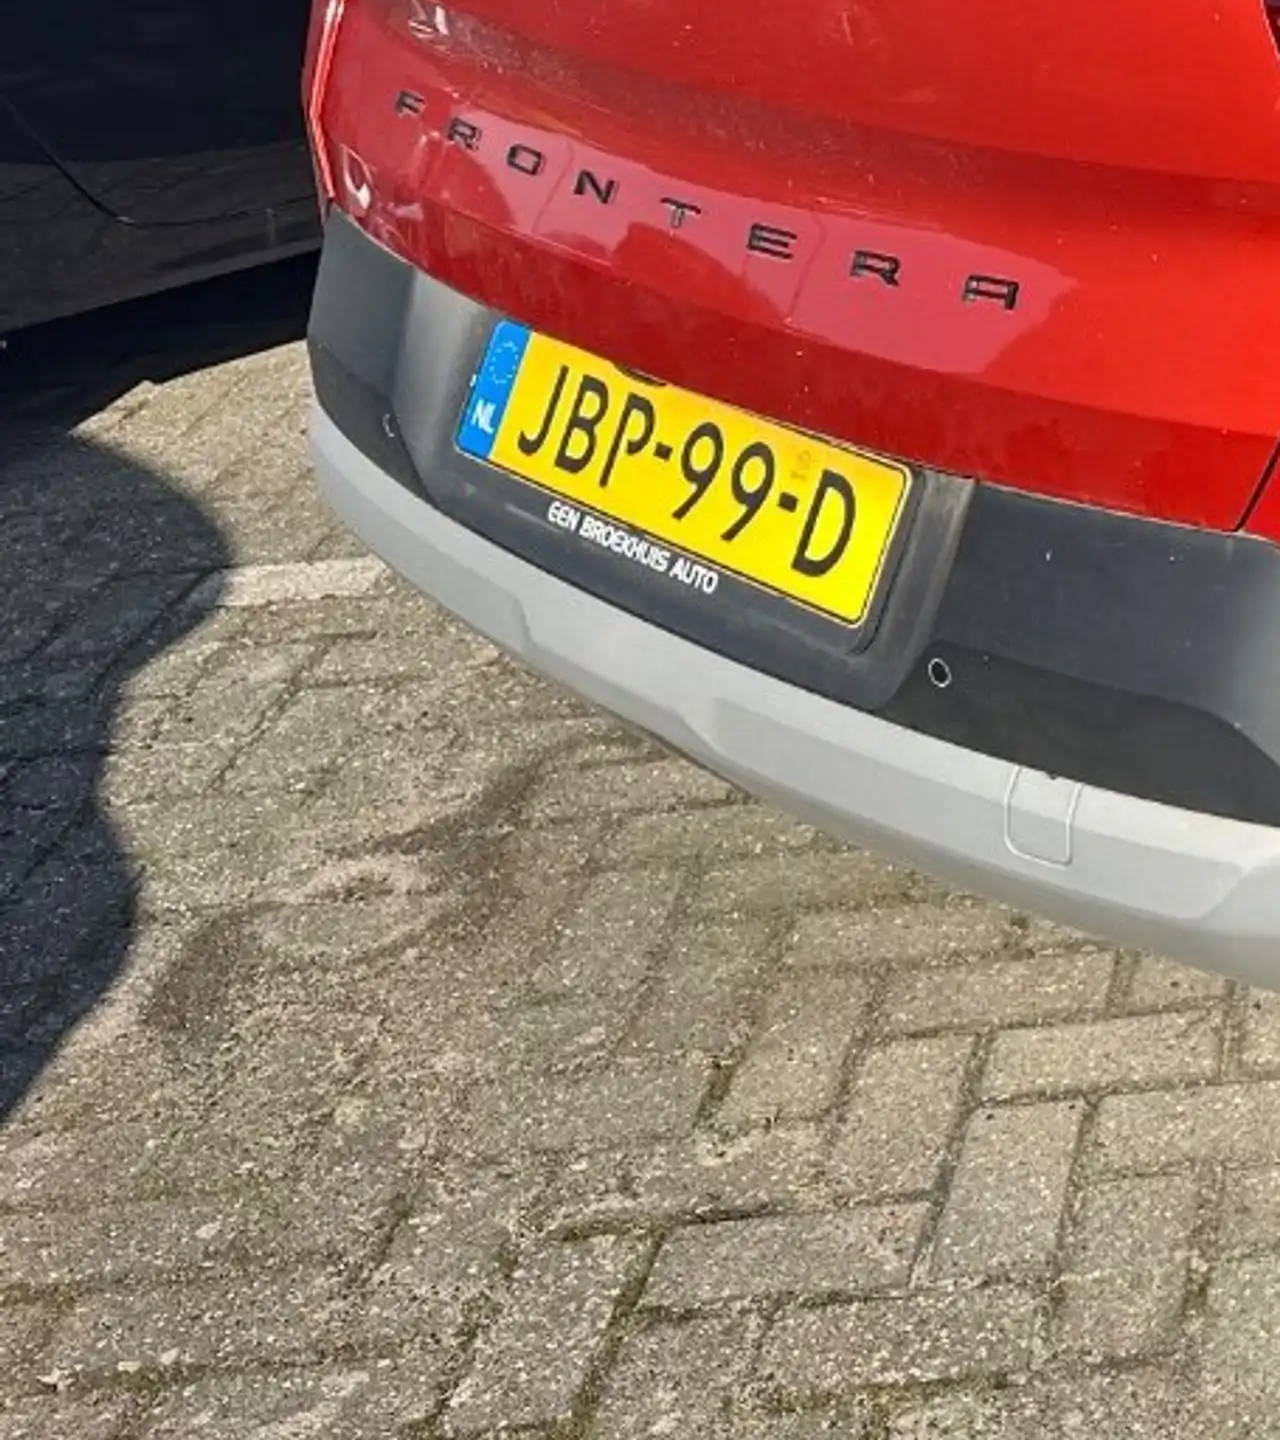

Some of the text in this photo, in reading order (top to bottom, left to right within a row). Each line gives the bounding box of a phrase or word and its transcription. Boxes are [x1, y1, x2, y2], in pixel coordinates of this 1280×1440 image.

[394, 89, 1021, 311] FRONTERA
[470, 397, 495, 435] NL
[517, 365, 857, 578] JBP-99-D
[547, 500, 719, 595] EEN BROEKHUIS AUTO
